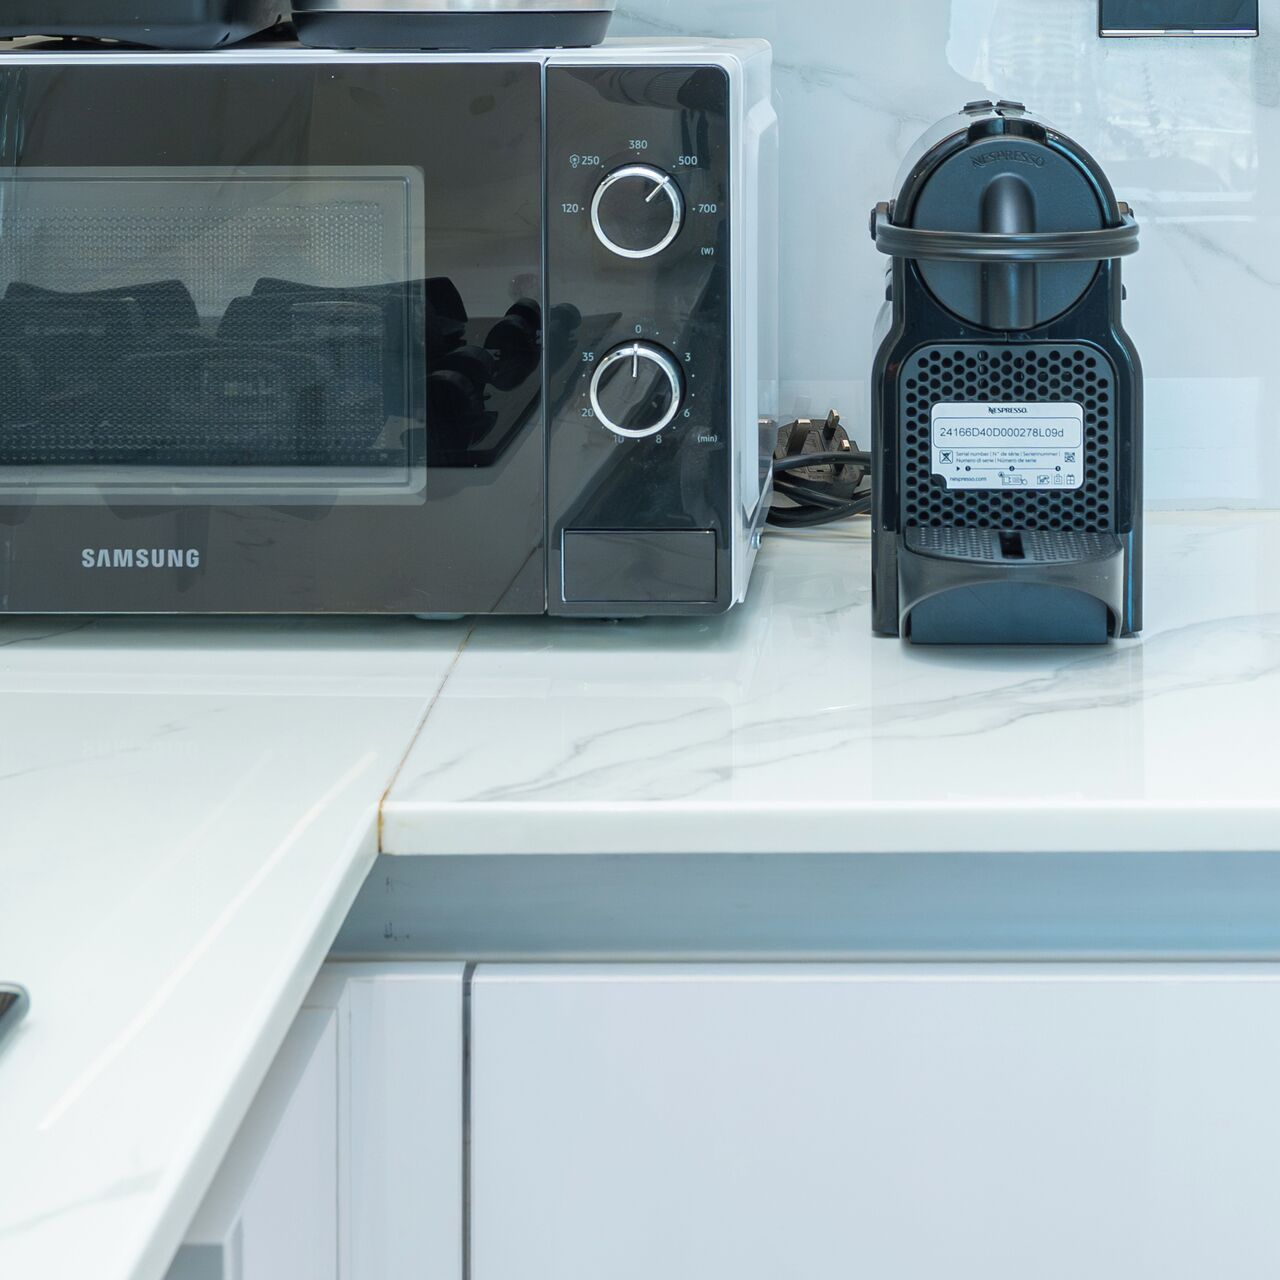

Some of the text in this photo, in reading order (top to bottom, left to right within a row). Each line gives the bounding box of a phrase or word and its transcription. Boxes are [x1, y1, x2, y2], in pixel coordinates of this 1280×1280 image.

[628, 140, 648, 150] 380
[581, 156, 600, 166] 250
[678, 156, 698, 166] 500
[561, 203, 579, 214] 120
[698, 204, 717, 214] 700
[700, 247, 715, 256] (W)
[634, 324, 642, 334] 0
[582, 352, 594, 362] 35
[684, 352, 691, 362] 3
[581, 408, 594, 418] 20
[683, 408, 690, 418] 6
[655, 435, 663, 445] 8
[697, 434, 718, 443] (min)
[81, 548, 200, 568] SAMSUNG
